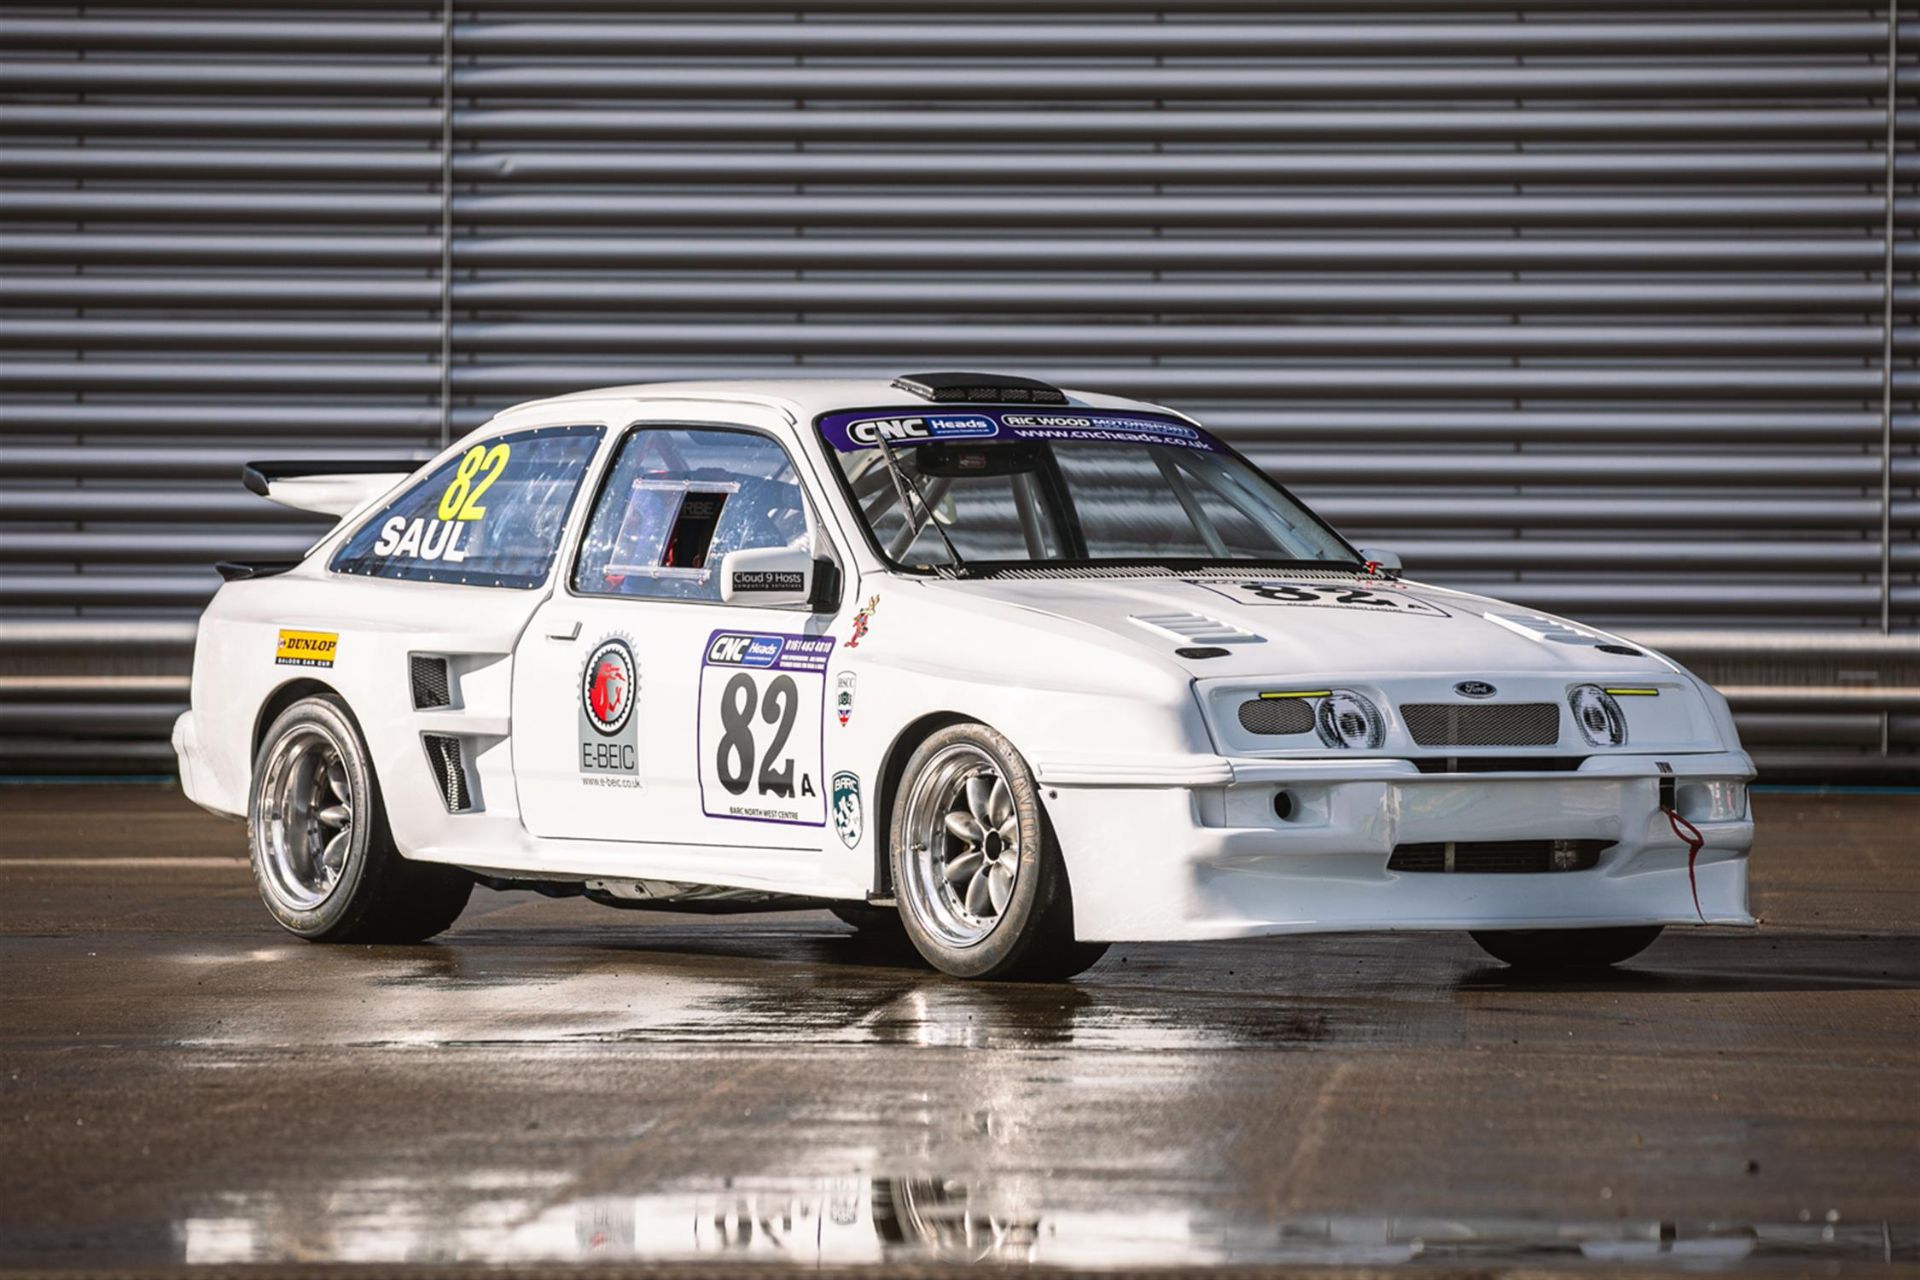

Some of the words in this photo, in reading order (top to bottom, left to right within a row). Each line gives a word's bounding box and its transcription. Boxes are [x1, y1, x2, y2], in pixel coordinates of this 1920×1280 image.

[854, 418, 929, 441] CNC
[931, 420, 988, 429] Heads
[1006, 416, 1032, 425] RIC
[1036, 417, 1091, 427] WOOD
[1013, 429, 1214, 451] www.cncheads.co.uk
[438, 443, 511, 521] 82
[374, 516, 470, 563] SAUL
[734, 572, 764, 583] Cloud
[766, 573, 773, 583] 9
[775, 573, 802, 583] Hosts
[1240, 584, 1399, 607] 82
[287, 638, 337, 651] DUNLOP
[710, 637, 751, 661] CNC
[749, 642, 777, 655] Heads
[716, 672, 799, 799] 82
[801, 773, 816, 797] A
[583, 742, 635, 770] E-BEIC
[834, 777, 857, 792] BARC
[730, 806, 744, 816] BARC
[744, 808, 763, 817] NORTH
[763, 809, 778, 818] WEST
[778, 811, 799, 820] CENTRE
